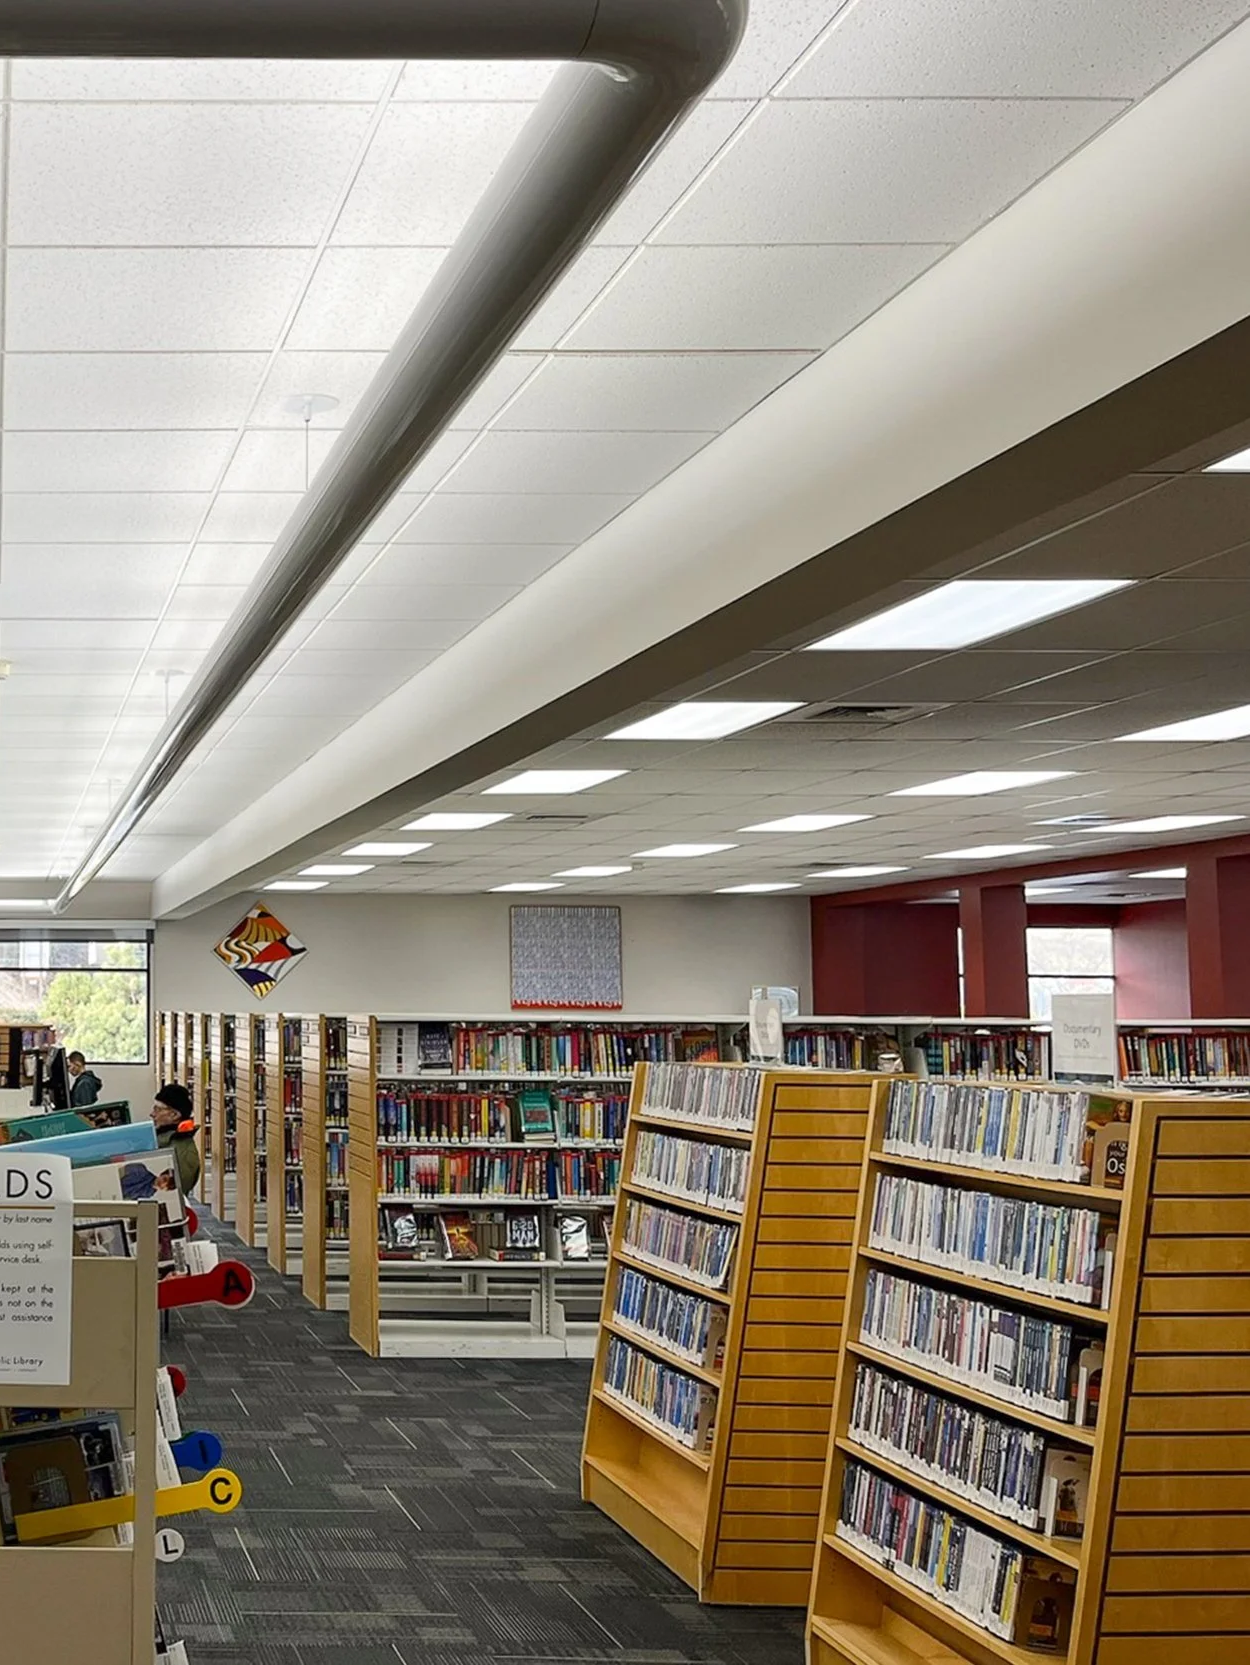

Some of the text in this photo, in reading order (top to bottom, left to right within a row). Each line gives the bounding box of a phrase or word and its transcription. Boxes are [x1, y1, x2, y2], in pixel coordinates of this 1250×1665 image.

[1062, 1023, 1102, 1038] Documentary
[3, 1214, 14, 1225] by
[15, 1214, 30, 1224] last
[30, 1216, 53, 1224] name
[511, 1229, 535, 1241] MAN
[12, 1241, 35, 1252] using
[21, 1254, 43, 1264] desk.
[1, 1283, 22, 1295] kept
[27, 1285, 37, 1294] at
[40, 1284, 54, 1294] the
[223, 1268, 247, 1298] A
[7, 1299, 21, 1308] not
[24, 1300, 37, 1308] on
[40, 1298, 54, 1308] the
[11, 1313, 54, 1323] assistance
[13, 1356, 44, 1368] Library
[209, 1476, 234, 1505] C
[162, 1534, 179, 1555] L
